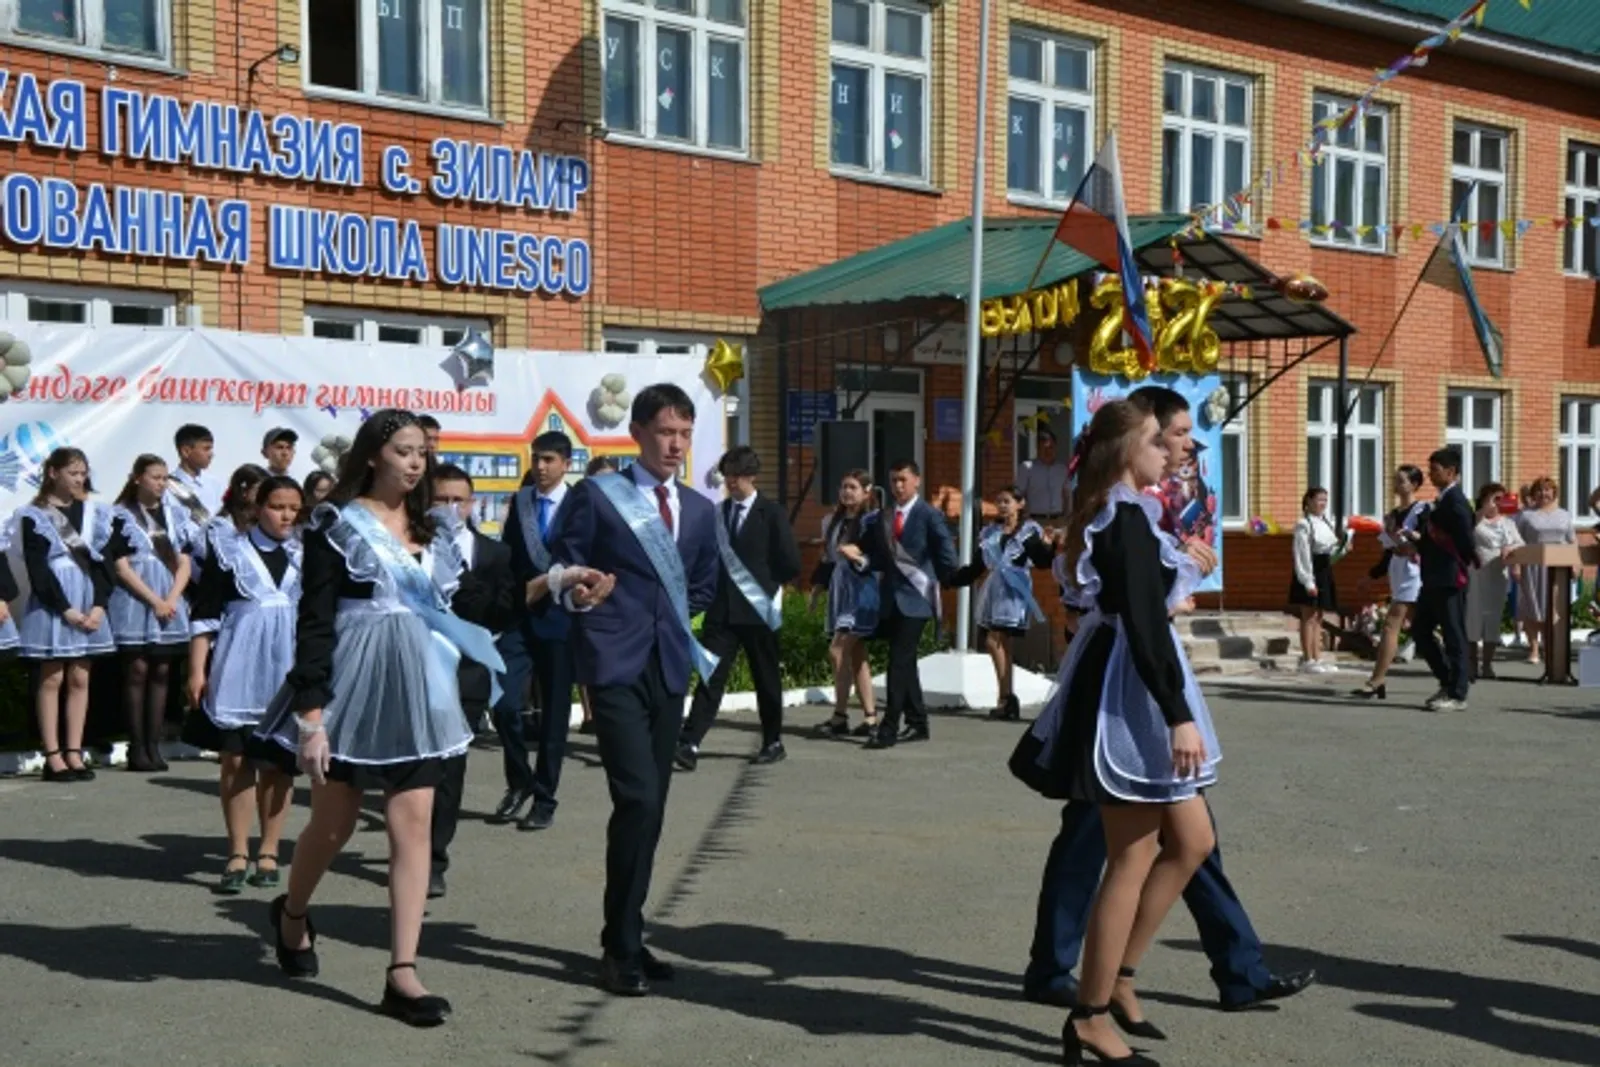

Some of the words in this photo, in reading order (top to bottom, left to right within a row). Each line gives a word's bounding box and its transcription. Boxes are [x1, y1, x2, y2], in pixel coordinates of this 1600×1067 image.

[659, 48, 672, 71] С
[711, 55, 725, 79] К
[103, 86, 363, 188] ГИМНАЗИЯ
[381, 147, 420, 195] с.
[430, 137, 589, 213] ЗИЛАИР
[3, 172, 250, 264] ОВАННАЯ
[269, 203, 429, 281] ШКОЛА
[437, 222, 591, 296] UNESCO
